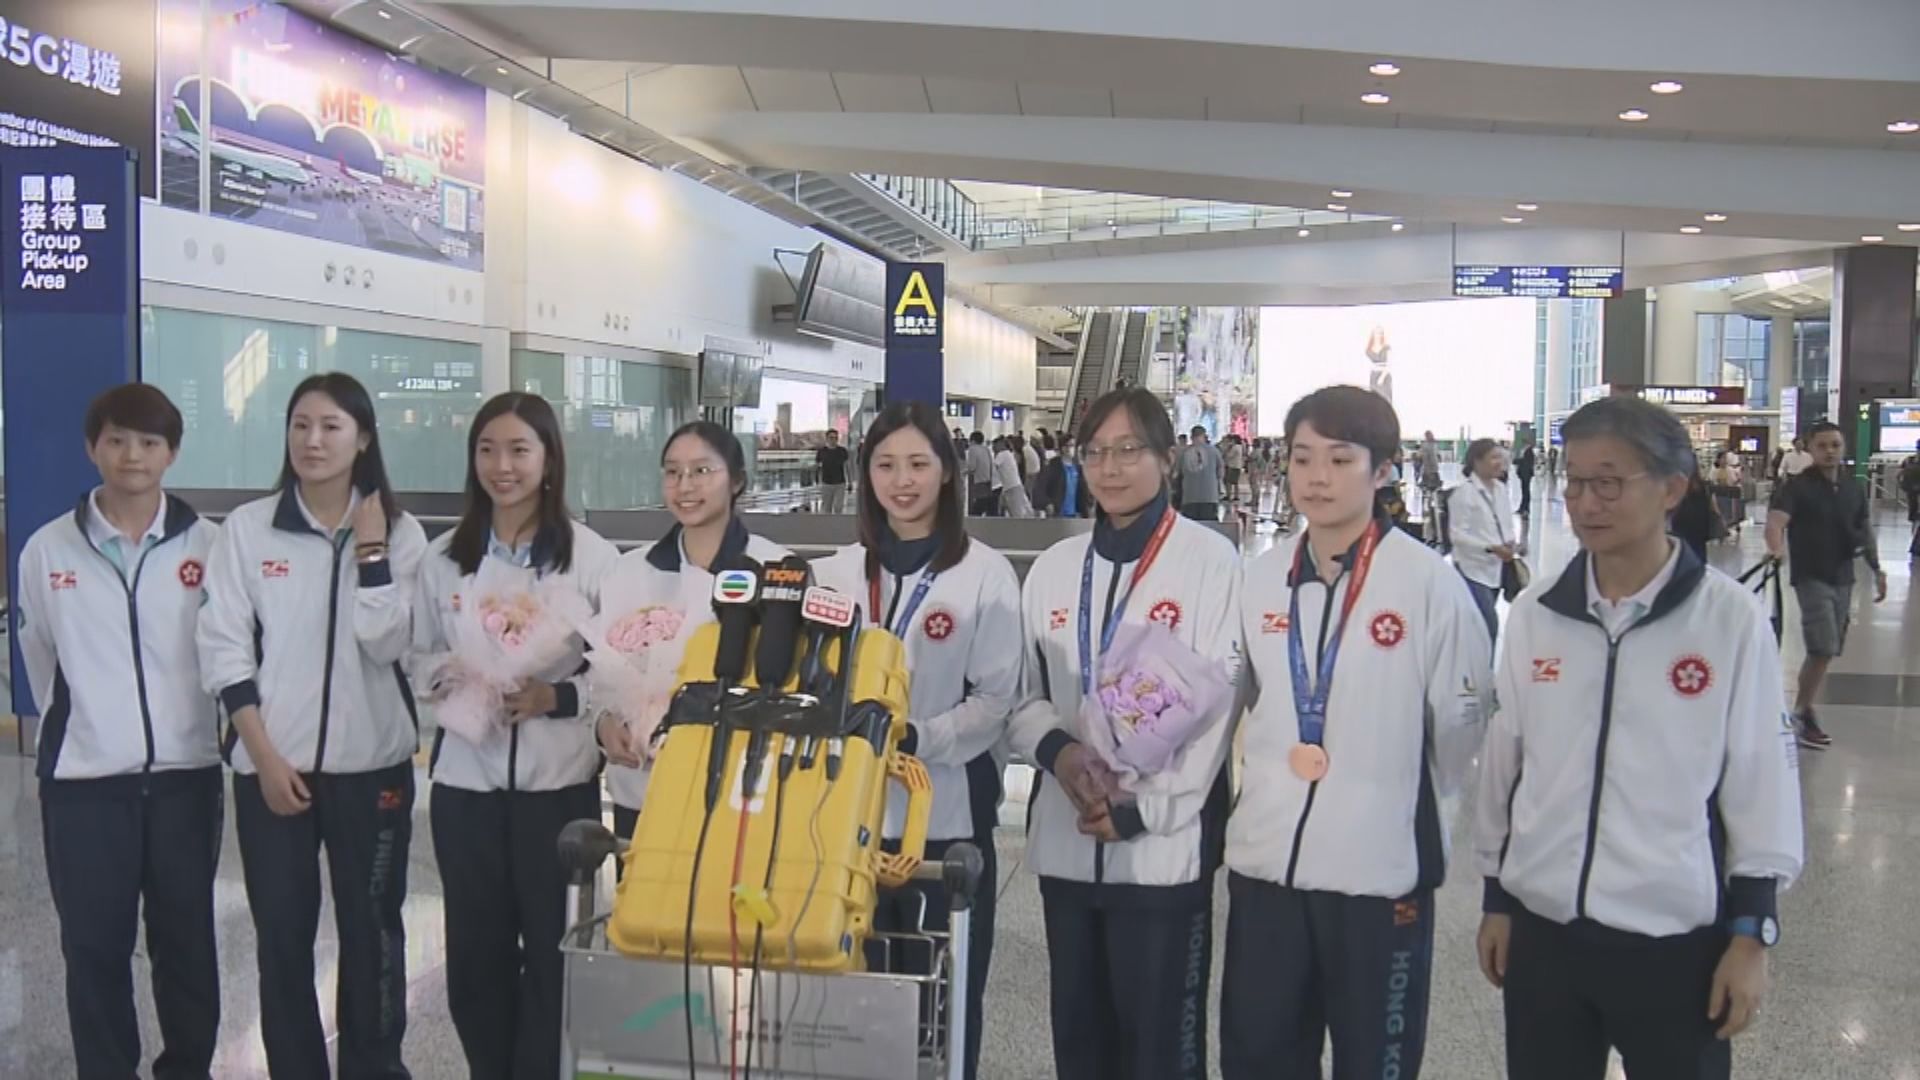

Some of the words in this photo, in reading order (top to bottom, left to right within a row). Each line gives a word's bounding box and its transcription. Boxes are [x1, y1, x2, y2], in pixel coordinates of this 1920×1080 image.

[20, 203, 107, 231] 接待區
[21, 231, 81, 252] Group
[21, 251, 88, 272] Pick-up
[21, 271, 66, 290] Area
[894, 271, 937, 317] A
[765, 569, 806, 582] now
[1185, 911, 1206, 989] HONG
[1386, 951, 1411, 1035] HONG
[1180, 996, 1198, 1070] KONG
[1383, 1043, 1402, 1080] KO
